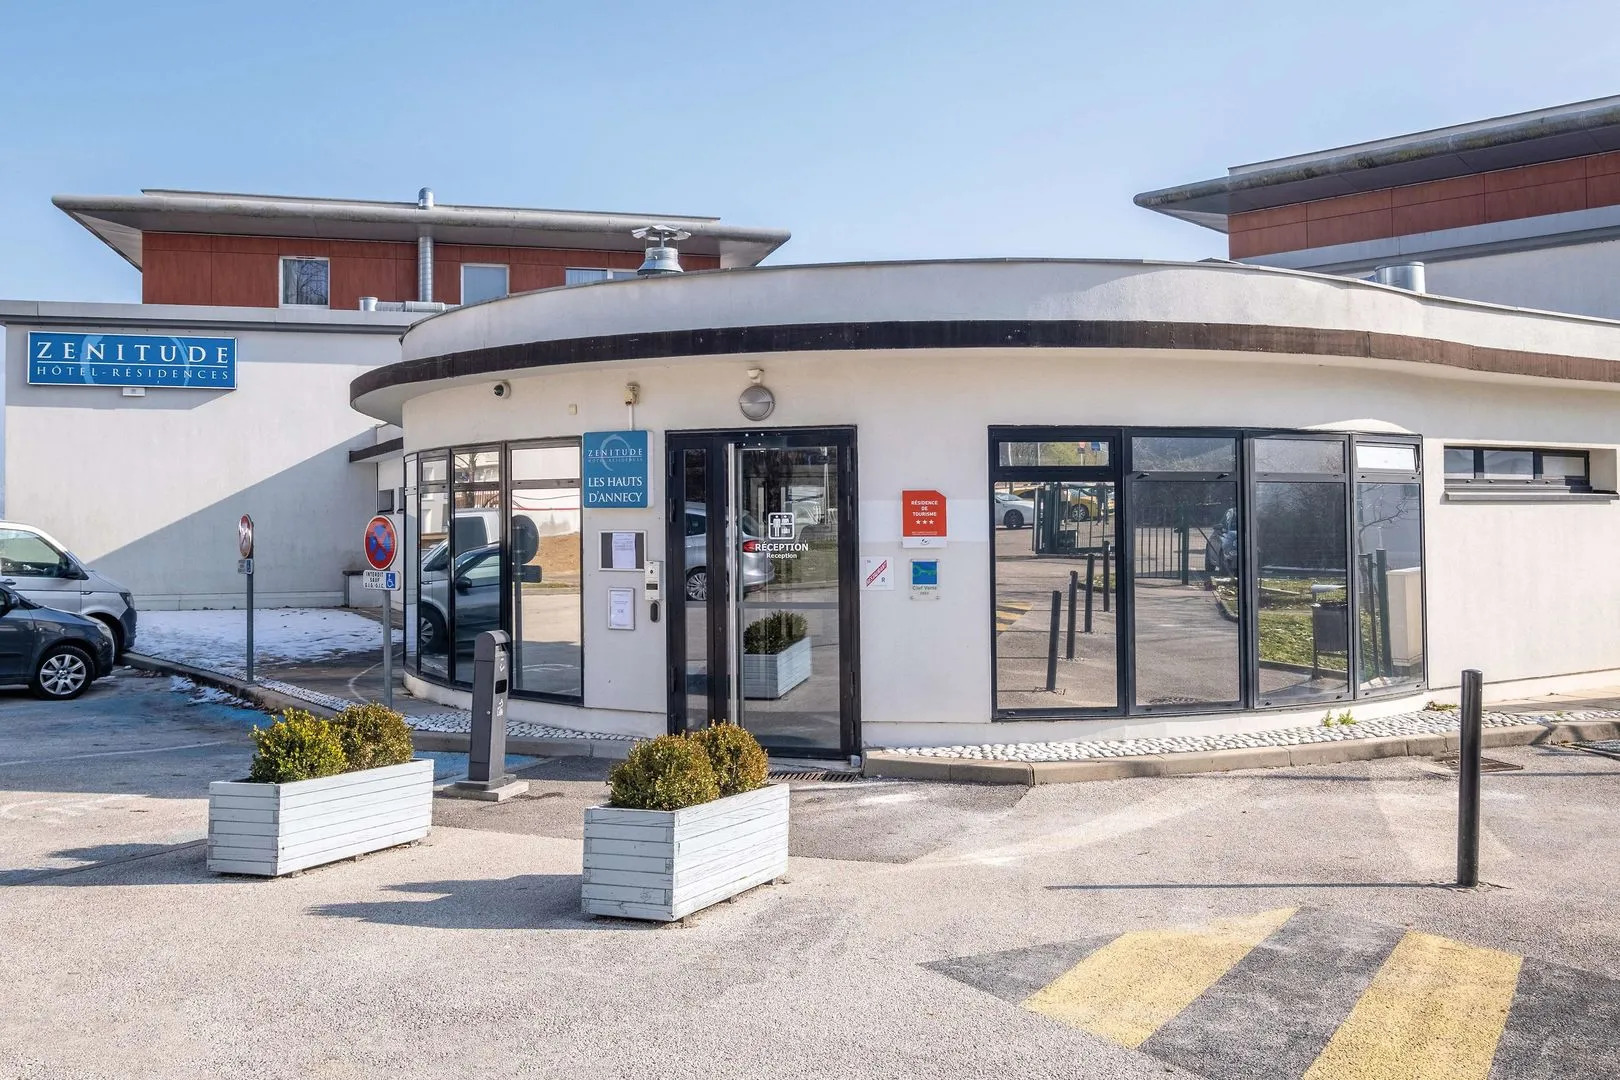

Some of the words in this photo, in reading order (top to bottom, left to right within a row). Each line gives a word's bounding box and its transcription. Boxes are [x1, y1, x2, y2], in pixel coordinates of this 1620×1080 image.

[37, 341, 229, 363] ZENITUDE
[588, 448, 643, 457] ZENITUDE
[588, 477, 605, 488] LES
[607, 476, 643, 487] HAUTS
[589, 490, 643, 503] D'ANNECY
[755, 540, 809, 552] RÉCEPTION
[766, 552, 798, 560] Reception
